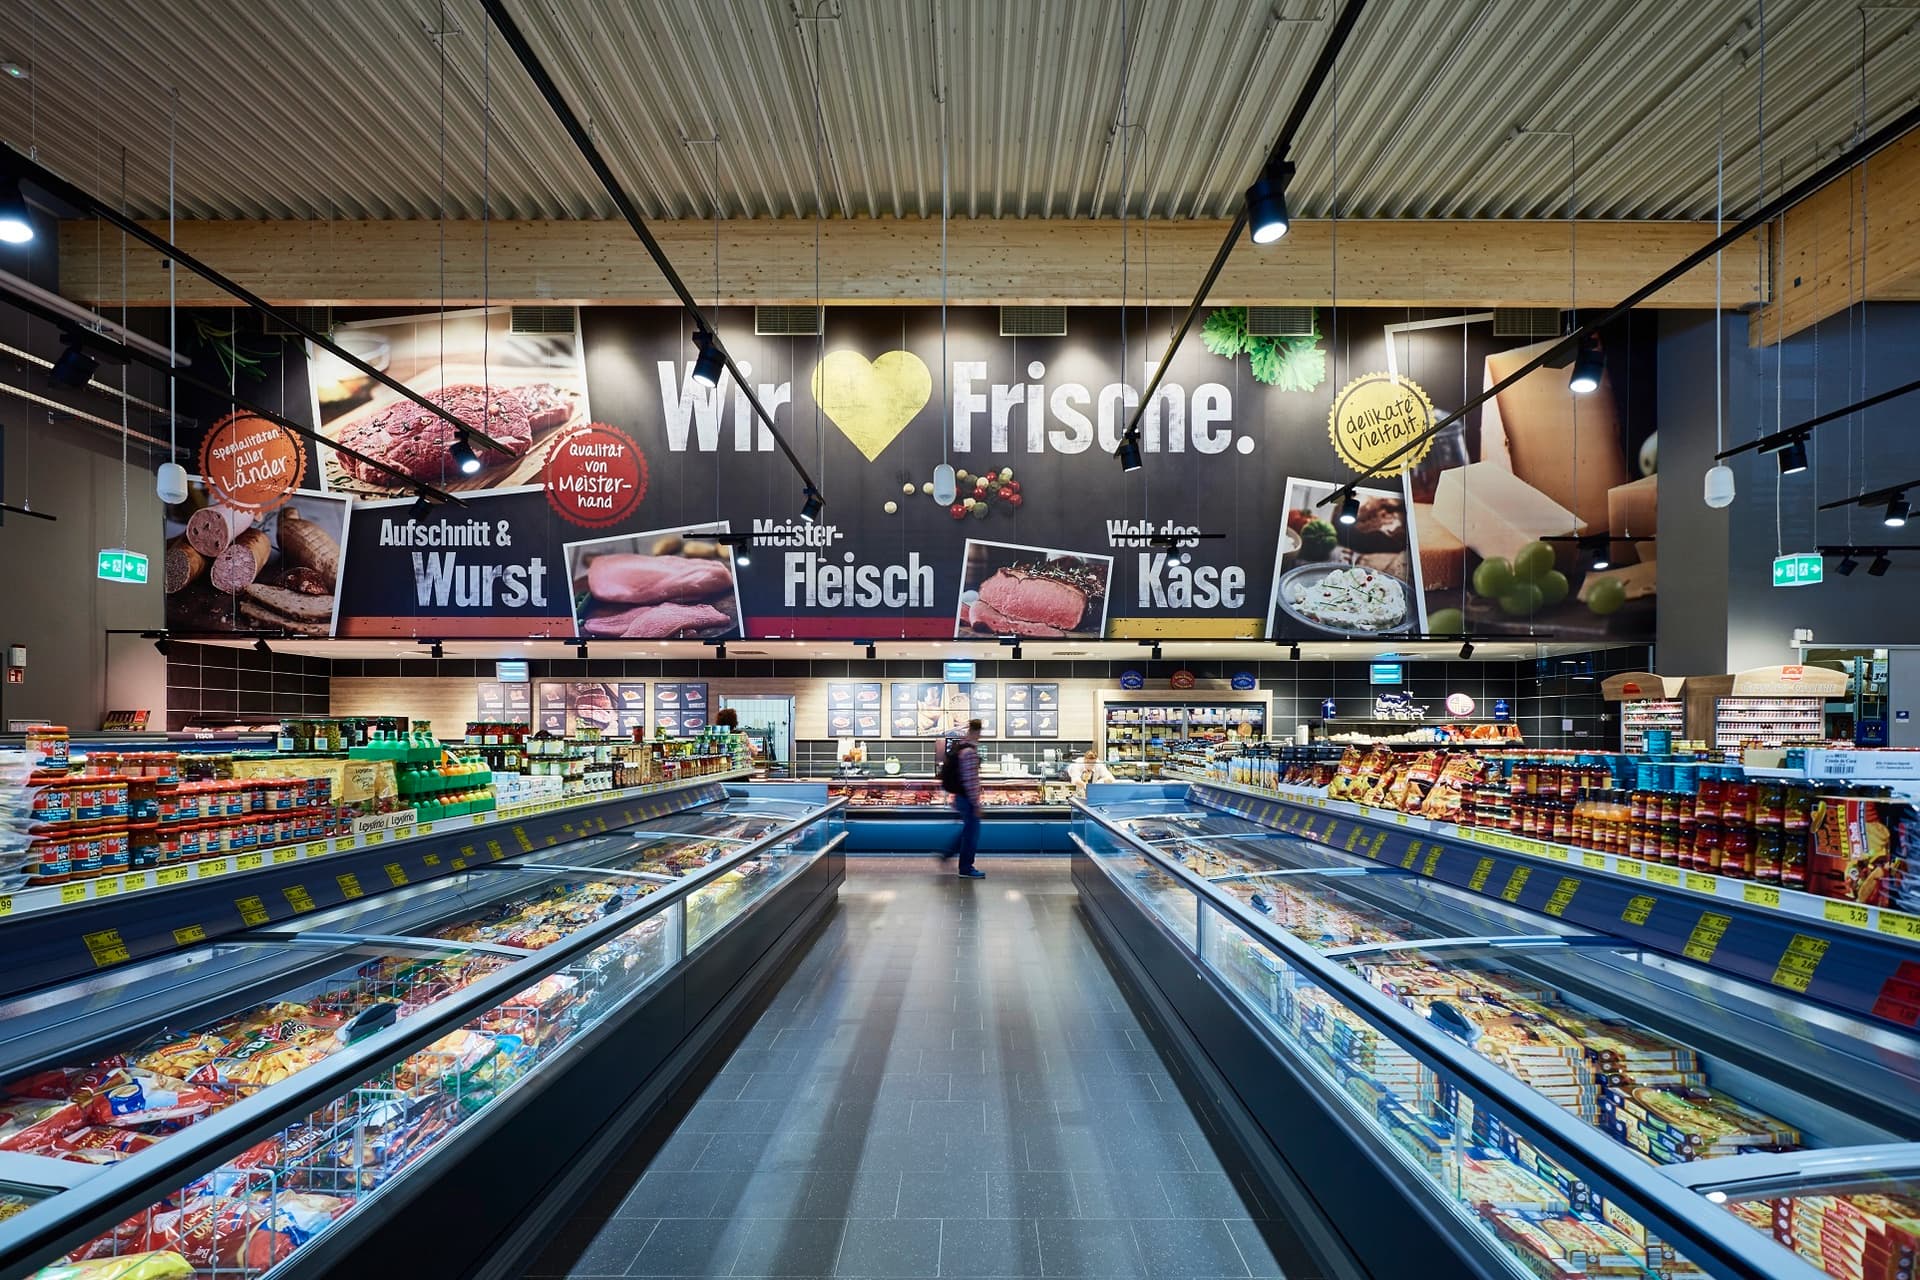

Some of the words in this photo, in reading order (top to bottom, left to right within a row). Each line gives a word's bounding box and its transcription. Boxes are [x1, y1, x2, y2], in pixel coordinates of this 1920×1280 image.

[657, 360, 791, 452] Wir
[953, 360, 1255, 455] Frische.
[1346, 399, 1413, 434] delikate
[237, 448, 264, 468] aller
[569, 443, 624, 457] Qualität
[222, 456, 287, 492] Länder
[585, 461, 608, 473] von
[559, 475, 632, 493] Meister-
[577, 494, 613, 508] hand
[379, 518, 491, 546] Aufschnitt
[495, 520, 512, 546] &
[752, 518, 844, 547] Meister-
[1106, 519, 1155, 548] Welt
[411, 551, 548, 608] Wurst
[784, 551, 935, 608] Fleisch
[1138, 552, 1246, 609] Käse
